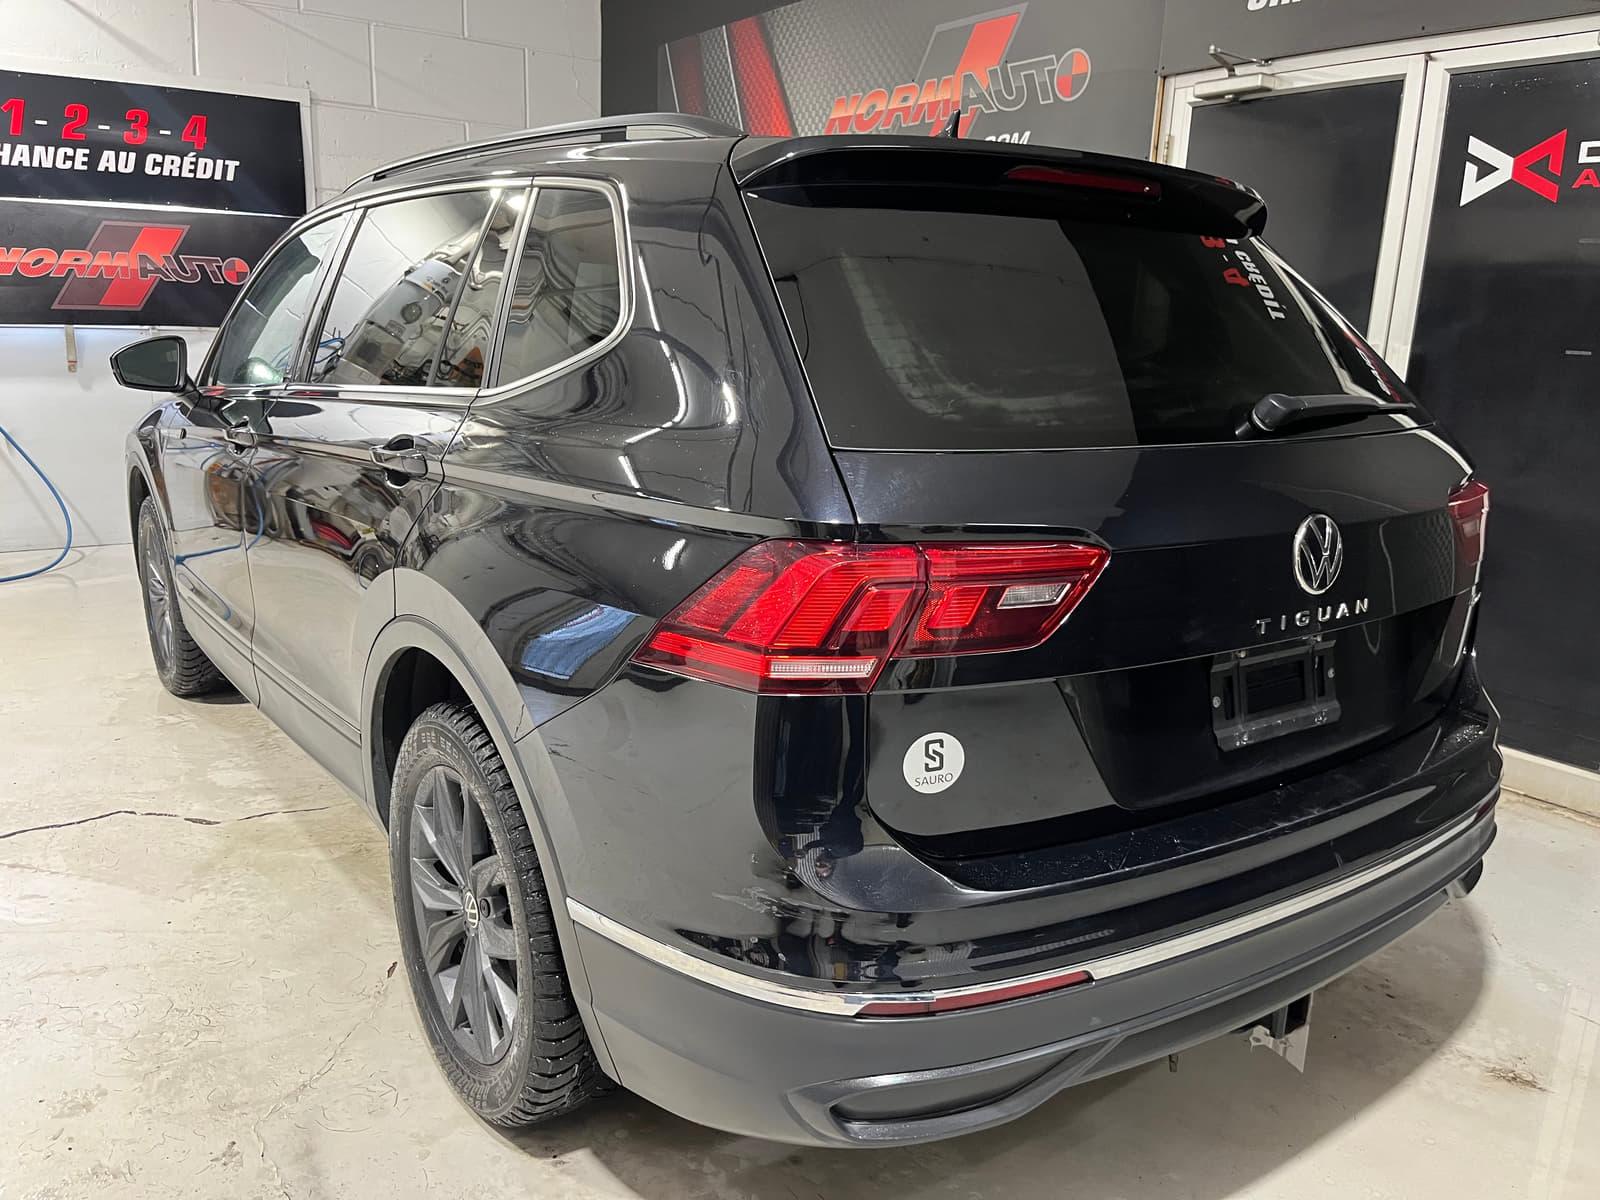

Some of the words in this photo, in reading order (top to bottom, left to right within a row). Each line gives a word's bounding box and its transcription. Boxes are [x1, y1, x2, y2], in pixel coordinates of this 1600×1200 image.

[97, 150, 137, 174] AU
[144, 152, 240, 182] CRÉDIT
[1255, 598, 1369, 635] TIGUAN
[914, 773, 953, 787] SAURO
